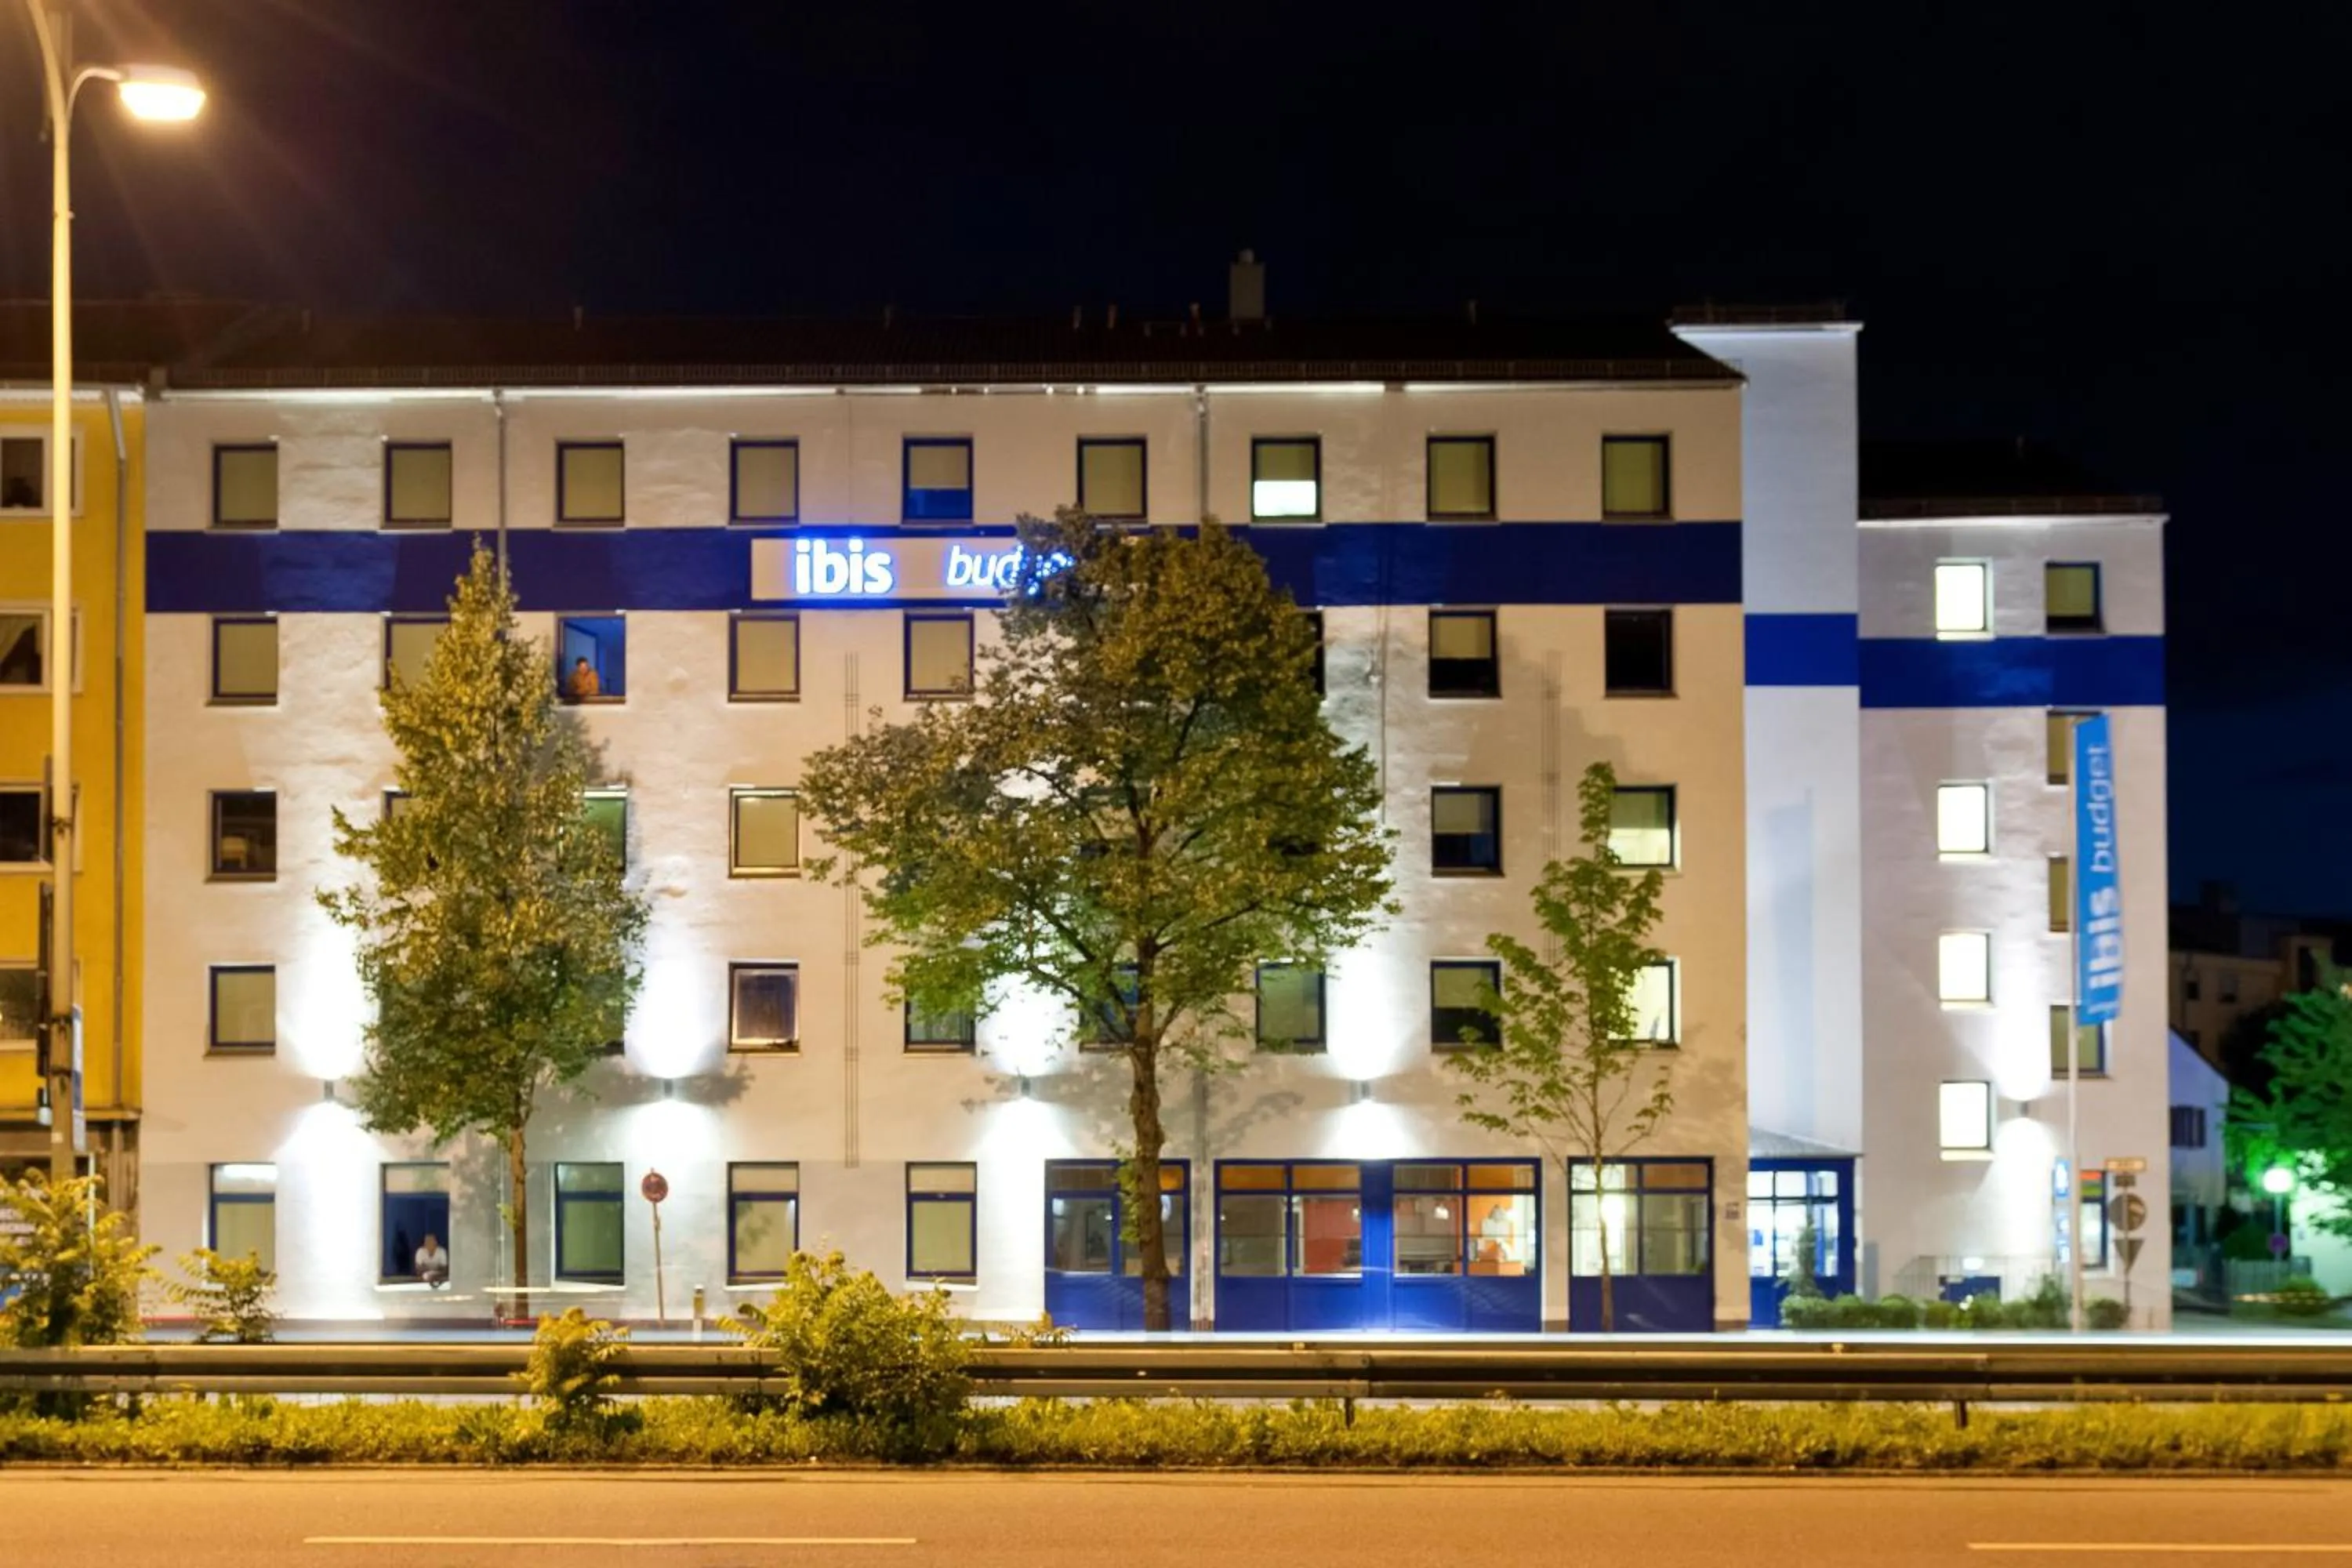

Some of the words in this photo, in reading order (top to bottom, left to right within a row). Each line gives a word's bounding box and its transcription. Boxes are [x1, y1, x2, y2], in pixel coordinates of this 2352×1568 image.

[796, 538, 894, 594] ibis
[946, 545, 1076, 596] bude
[2086, 744, 2114, 873] budget
[2088, 886, 2122, 990] ibis
